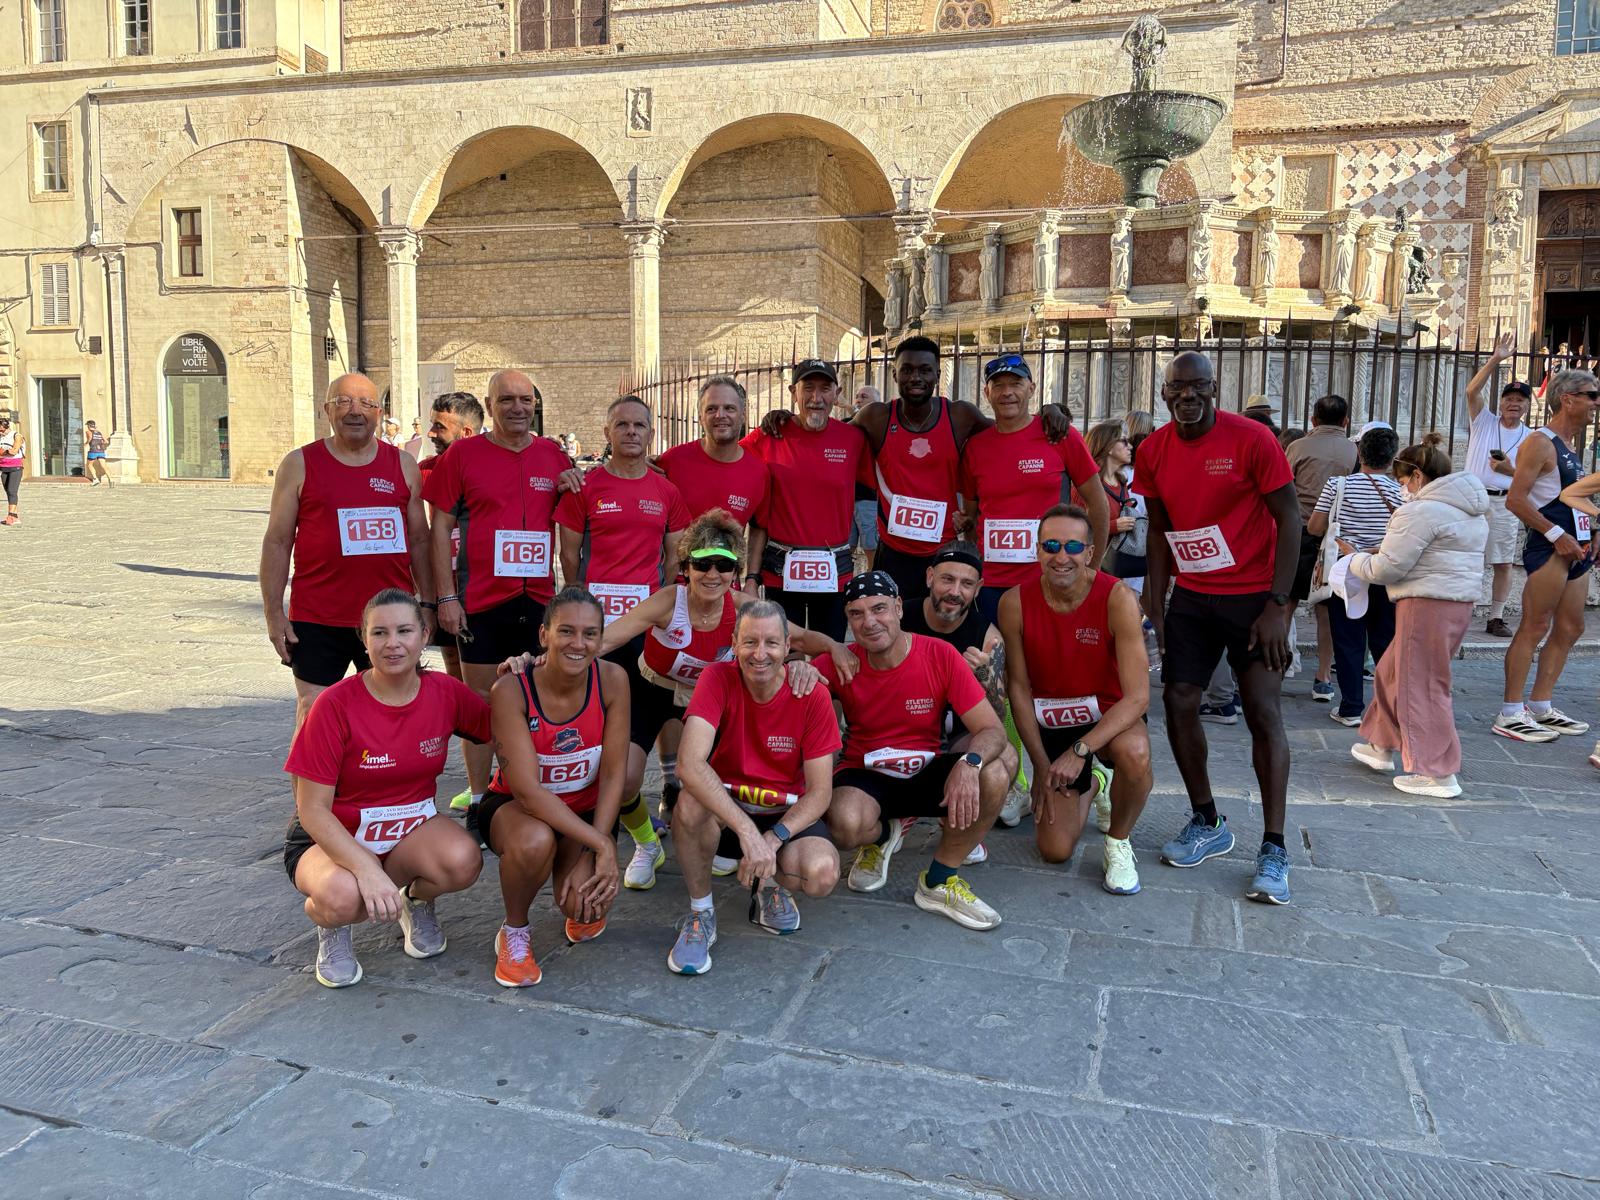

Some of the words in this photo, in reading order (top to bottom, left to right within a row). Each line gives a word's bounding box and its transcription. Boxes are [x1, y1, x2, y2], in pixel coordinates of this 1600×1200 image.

[181, 338, 204, 346] LIBRE
[182, 358, 208, 366] VOLTE
[1018, 458, 1044, 466] ATLETICA
[369, 477, 395, 487] ATLETICA
[898, 508, 937, 529] 150
[349, 520, 395, 540] 158
[990, 531, 1031, 549] 141
[1177, 539, 1218, 560] 163
[504, 543, 545, 563] 162
[791, 562, 830, 579] 159
[1044, 707, 1091, 726] 145
[539, 761, 587, 783] 164
[739, 784, 778, 808] NC
